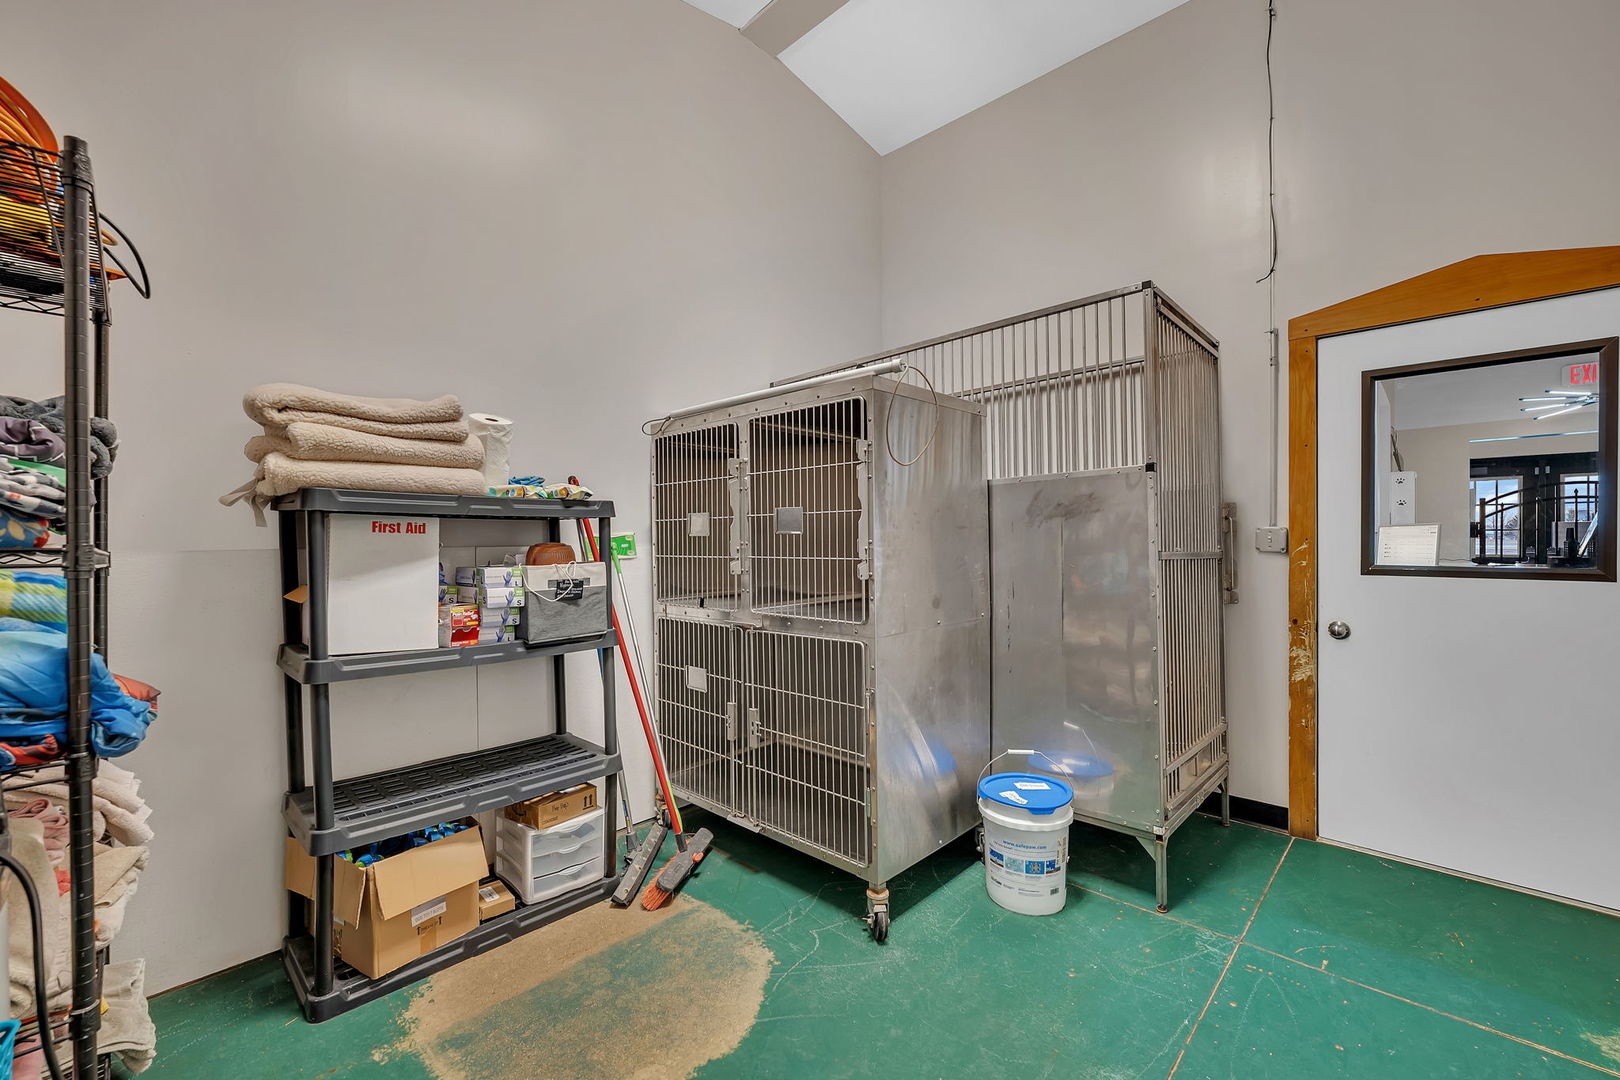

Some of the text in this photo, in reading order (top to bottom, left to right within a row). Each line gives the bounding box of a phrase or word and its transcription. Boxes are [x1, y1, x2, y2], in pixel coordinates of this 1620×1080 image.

[371, 521, 426, 534] First Aid
[1003, 840, 1047, 850] www.safepaw.com
